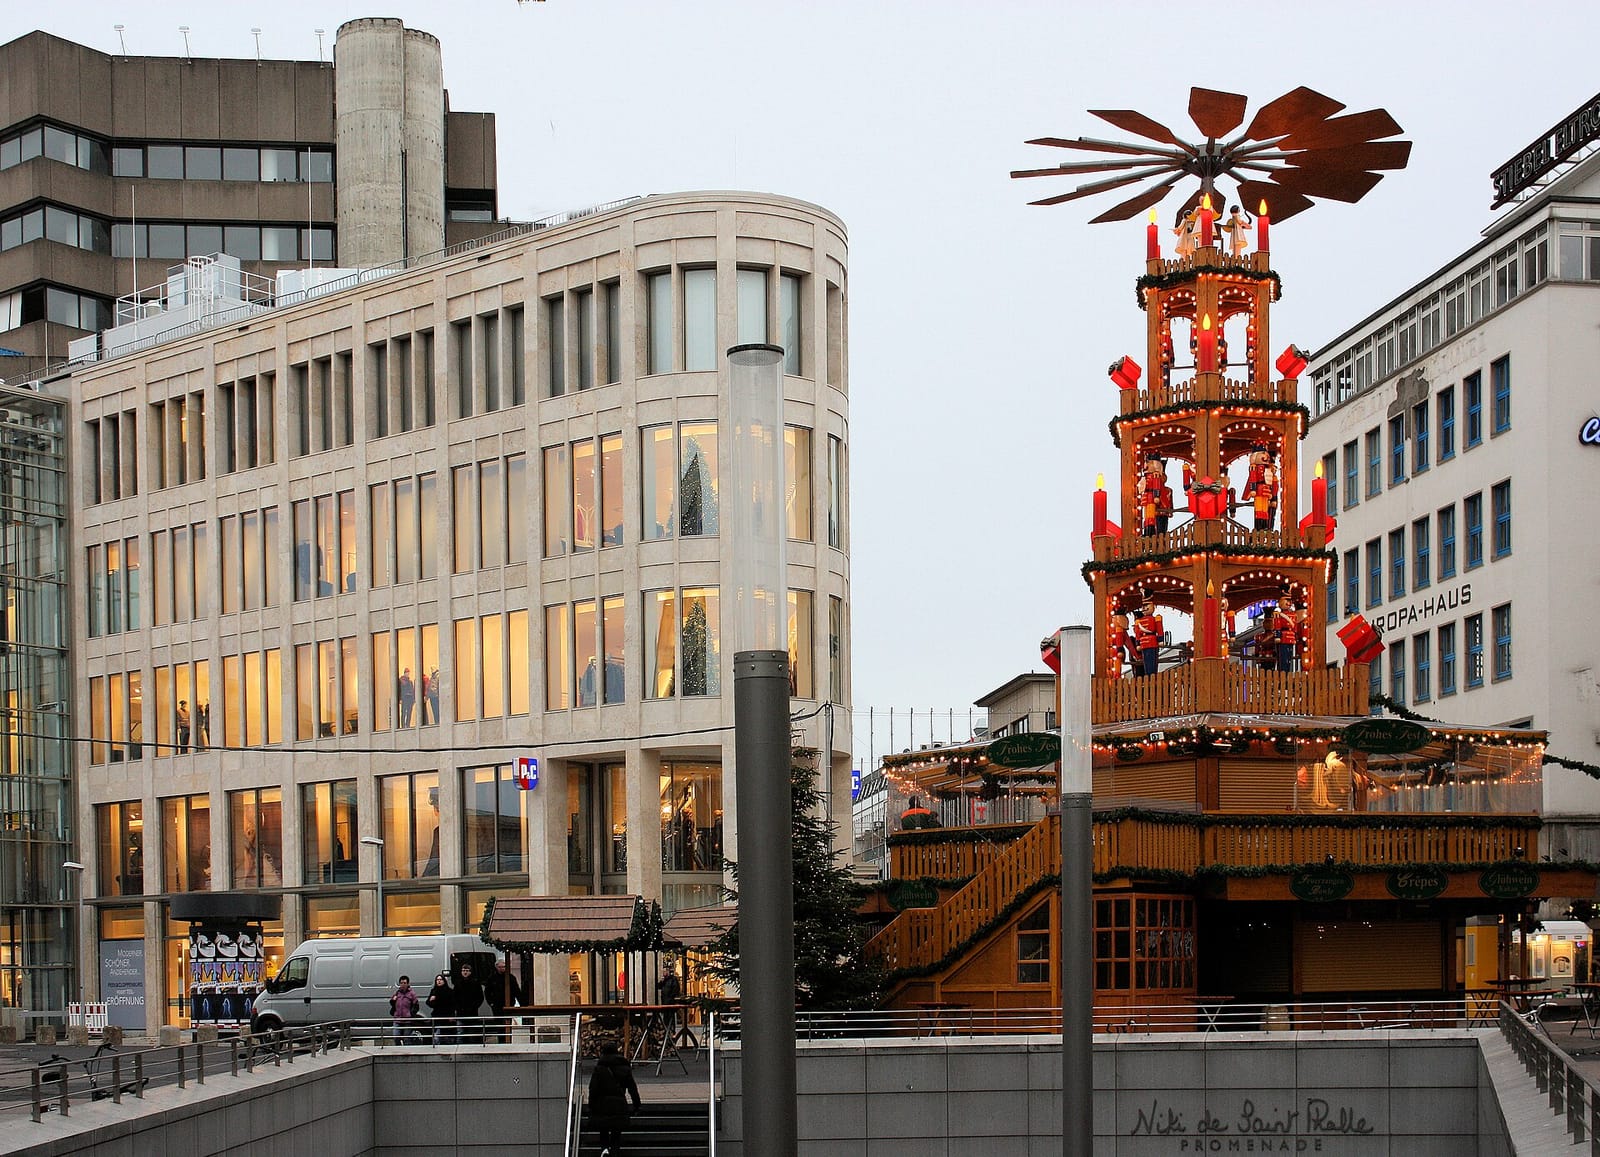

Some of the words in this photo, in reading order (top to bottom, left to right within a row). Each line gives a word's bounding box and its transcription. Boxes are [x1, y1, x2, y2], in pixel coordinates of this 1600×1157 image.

[1494, 139, 1550, 200] STIEBEL
[1582, 418, 1600, 443] C
[1353, 723, 1393, 740] Frohes
[997, 740, 1033, 757] Frohes
[1035, 736, 1060, 753] Fest
[520, 764, 537, 780] P&C
[1396, 872, 1440, 891] Crêpes
[106, 995, 145, 1006] ERÖFFNUNG
[1131, 1099, 1187, 1135] Niki
[1197, 1108, 1229, 1134] de
[1237, 1098, 1299, 1134] Saint
[1180, 1139, 1324, 1152] PROMENADE
